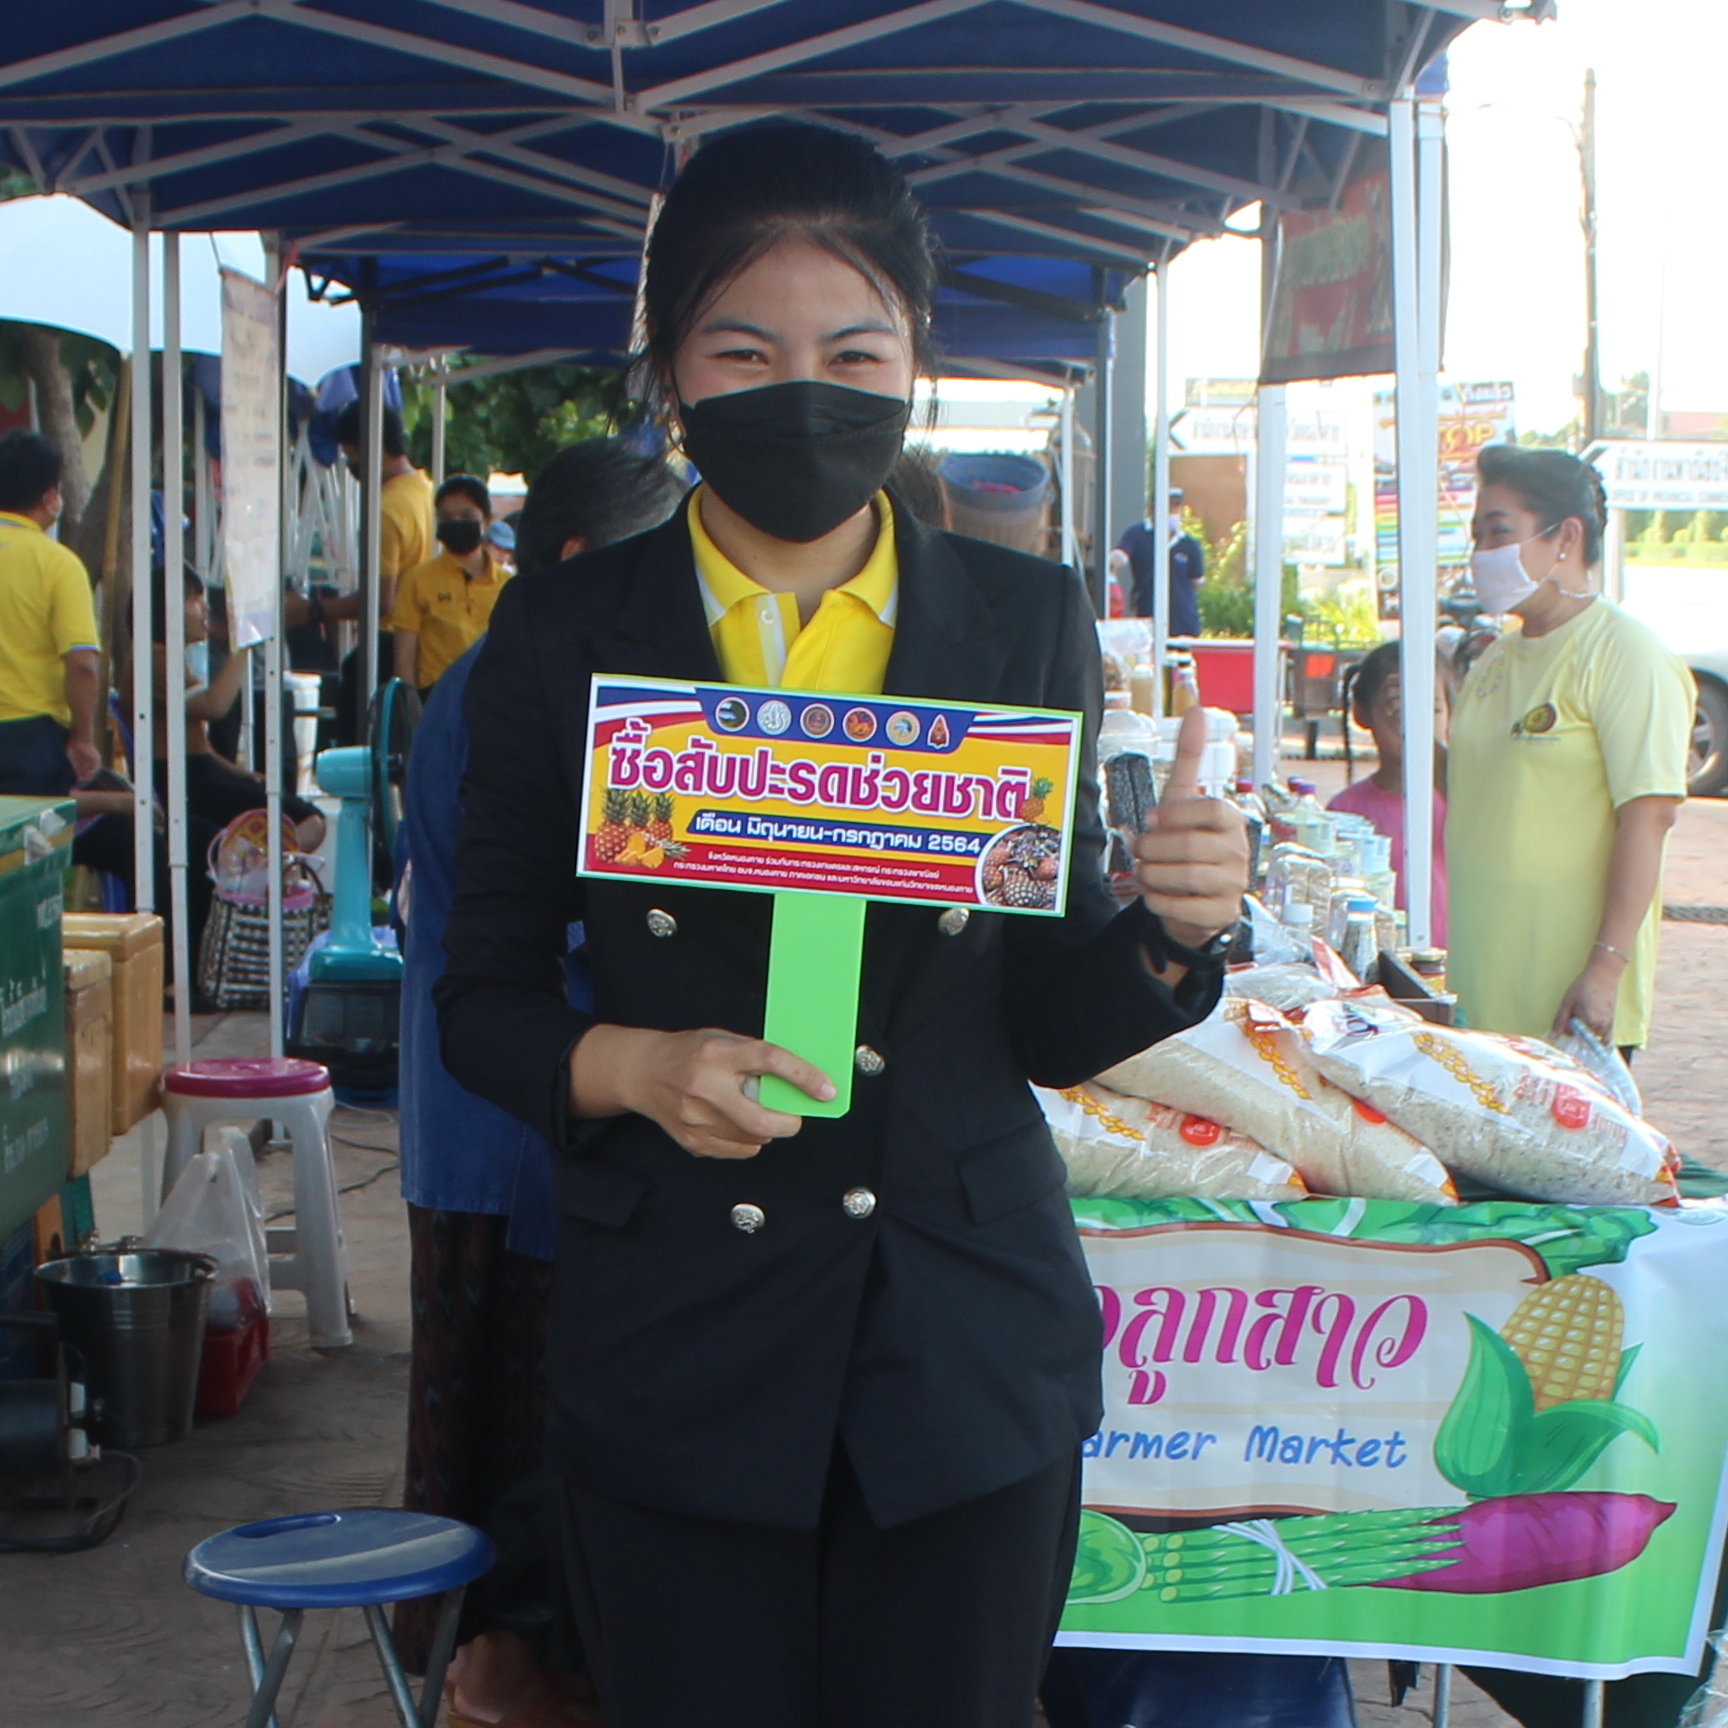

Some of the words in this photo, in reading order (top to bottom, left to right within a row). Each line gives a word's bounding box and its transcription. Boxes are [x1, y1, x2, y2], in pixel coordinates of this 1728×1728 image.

[608, 718, 1032, 822] ซื้อสับปะรดช่วยชาติ
[695, 811, 741, 834] เดือน
[746, 815, 923, 850] มิถุนายน-กรกฎาคม
[927, 833, 982, 855] 2564
[1243, 1424, 1409, 1470] Market
